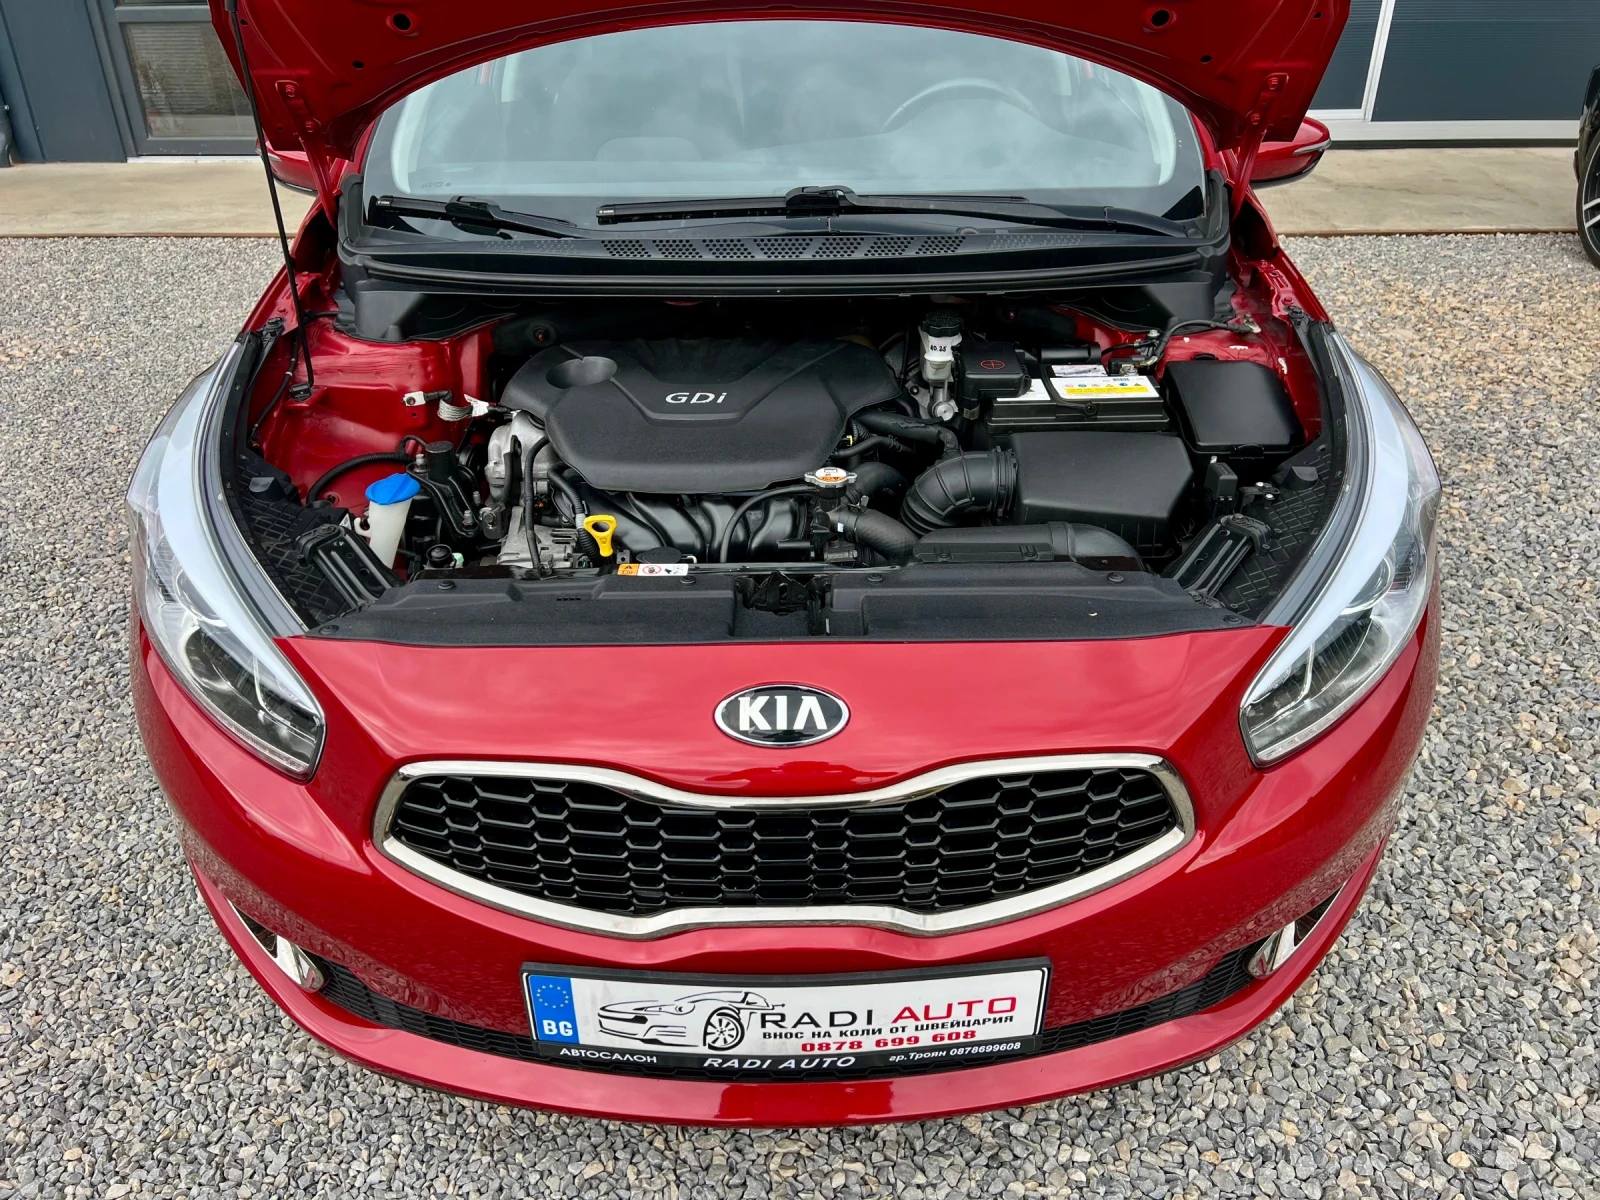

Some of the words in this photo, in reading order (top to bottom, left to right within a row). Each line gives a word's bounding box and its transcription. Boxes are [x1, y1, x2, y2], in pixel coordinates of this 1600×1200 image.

[665, 392, 728, 404] GDi
[738, 695, 828, 731] KIA
[760, 1009, 873, 1029] RADI
[891, 996, 1017, 1024] AUTO
[543, 1019, 573, 1037] BG
[762, 1031, 804, 1040] ВНОС
[811, 1031, 832, 1039] НА
[839, 1028, 883, 1038] КОЛИ
[889, 1024, 908, 1034] ОТ
[914, 1015, 1014, 1032] ШВЕЙЦАРИЯ
[801, 1040, 863, 1053] 0878
[874, 1035, 920, 1049] 699
[931, 1030, 977, 1043] 608
[949, 1041, 1021, 1056] 0878699608
[559, 1047, 658, 1064] АВТОСАЛОН
[703, 1058, 771, 1070] RADI
[778, 1056, 856, 1070] AUTO
